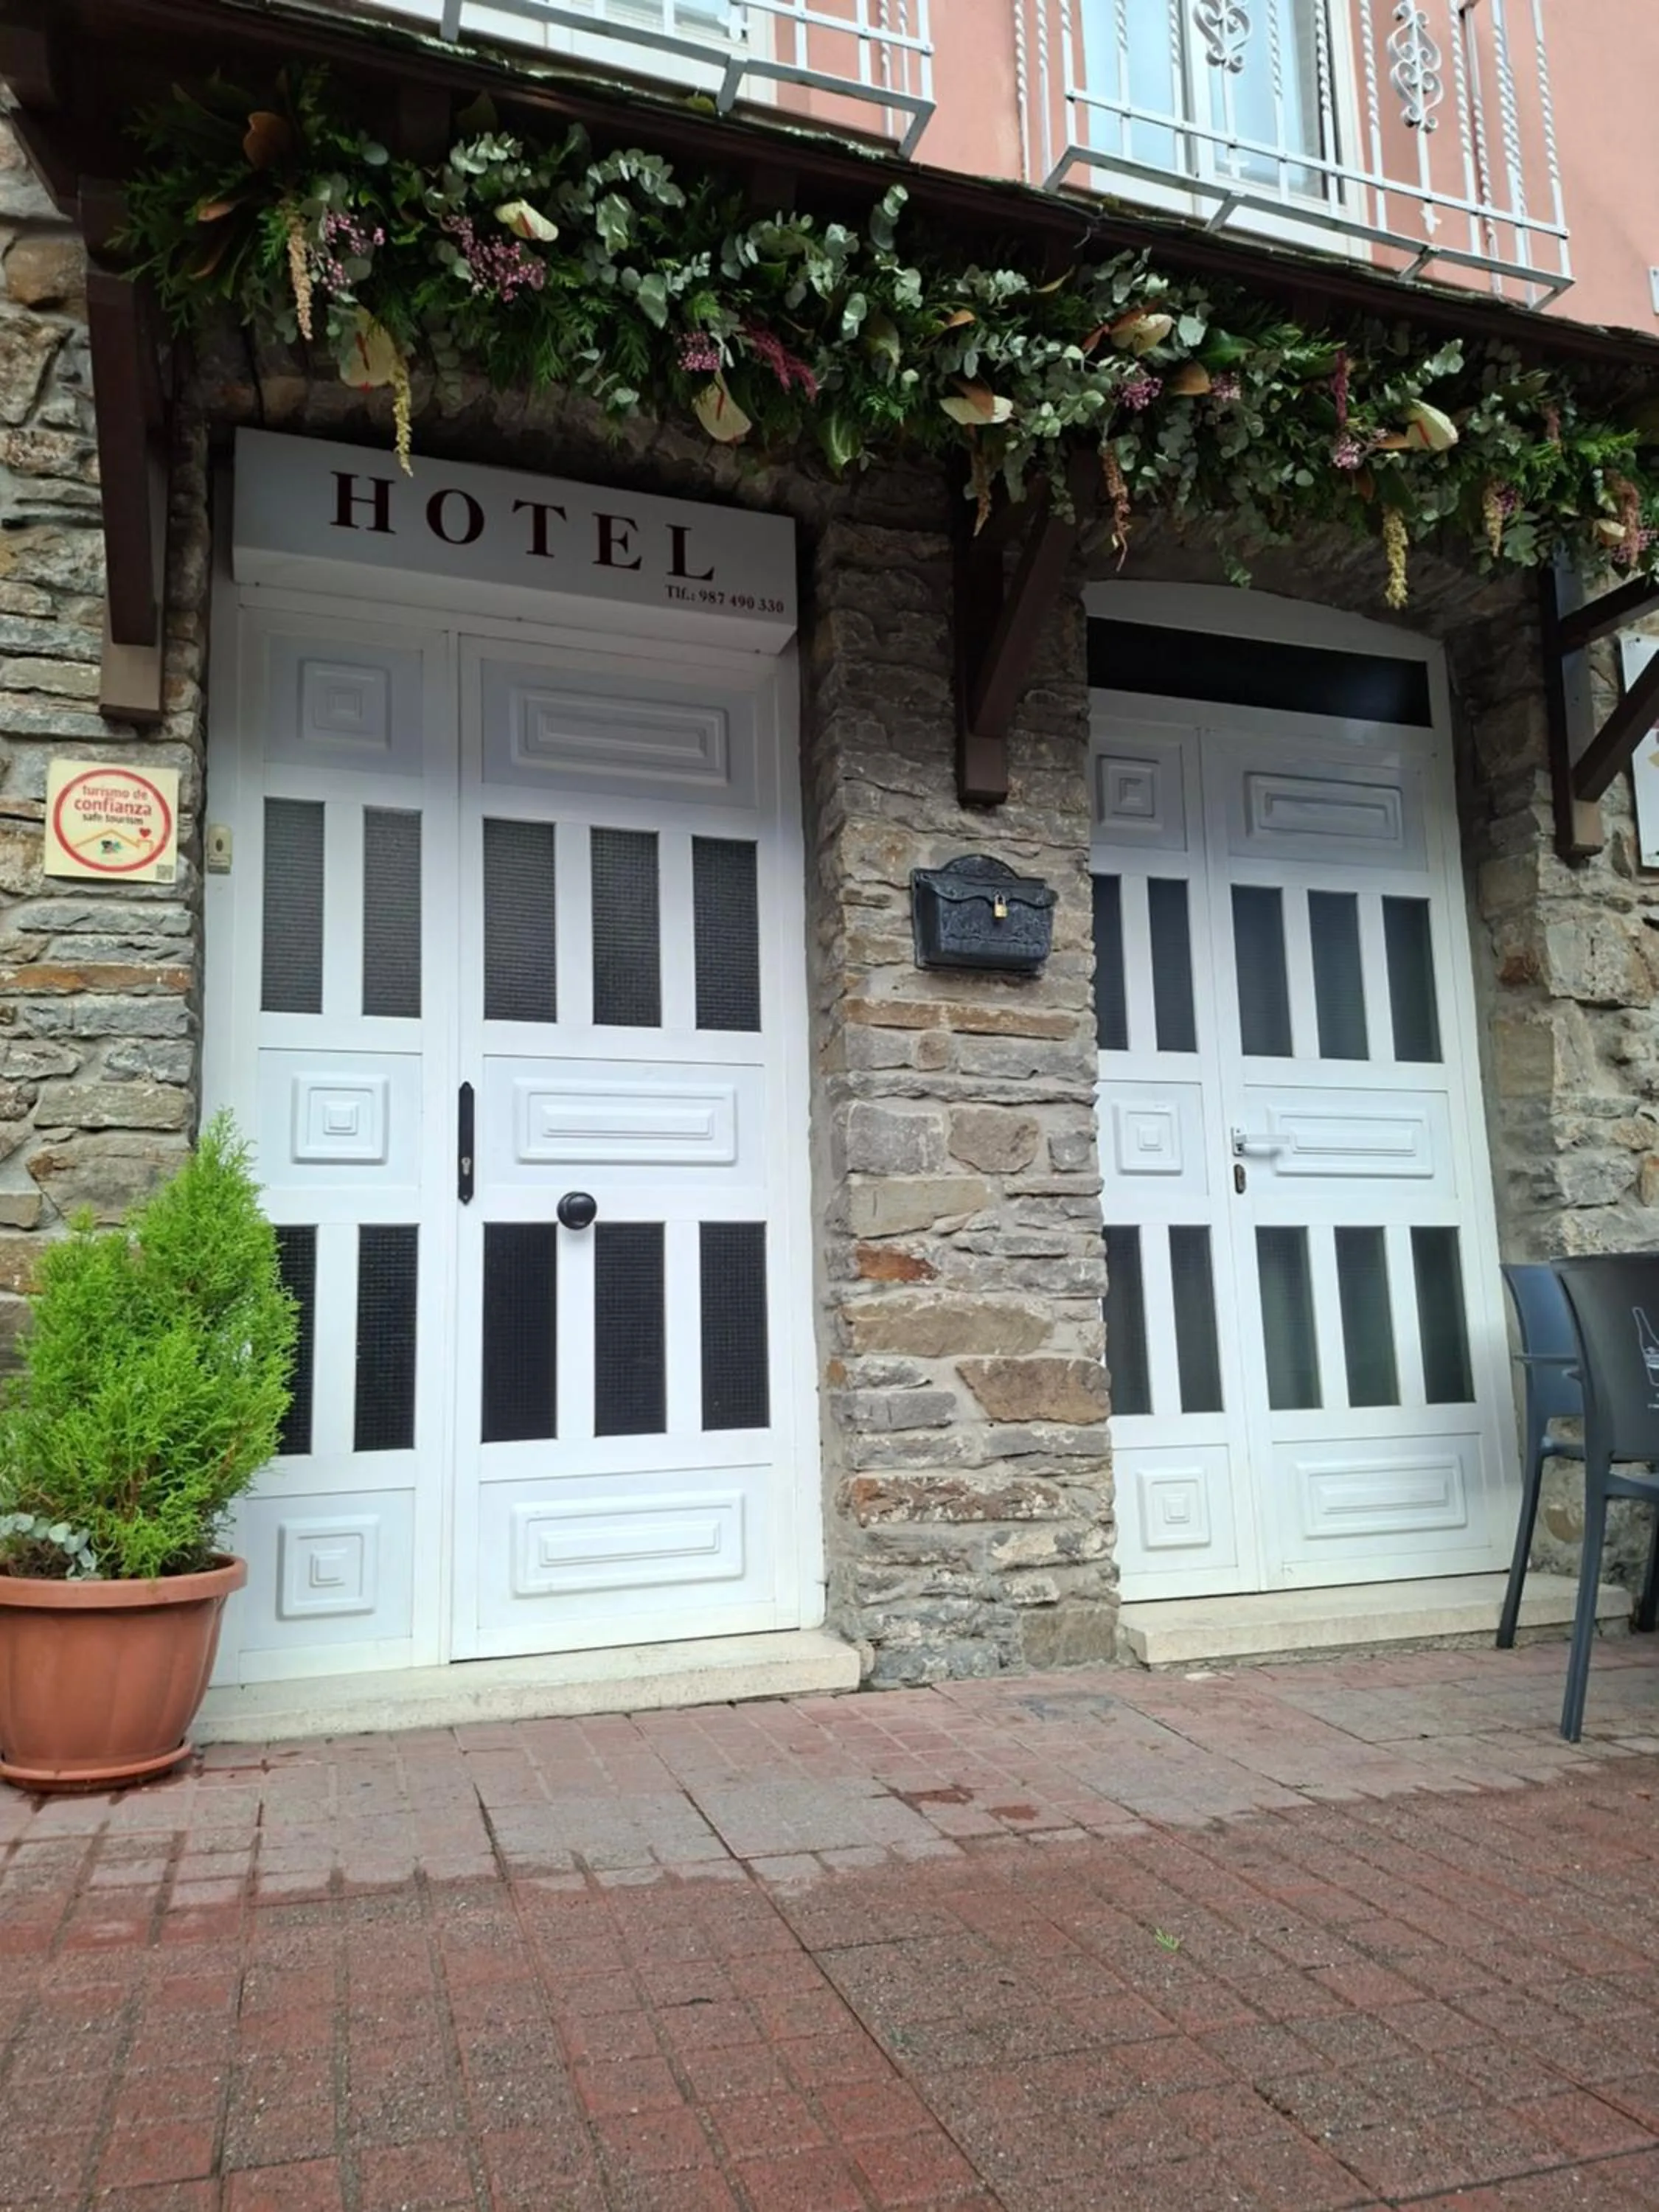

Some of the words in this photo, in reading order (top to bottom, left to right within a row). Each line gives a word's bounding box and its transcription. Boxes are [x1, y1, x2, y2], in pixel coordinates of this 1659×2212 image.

[330, 470, 714, 581] HOTEL
[699, 590, 724, 605] 987
[730, 594, 754, 610] 490
[758, 598, 785, 613] 330
[83, 785, 130, 799] turismo
[133, 789, 147, 800] de
[74, 797, 152, 816] confianza
[83, 813, 102, 821] safe
[105, 814, 144, 825] tourism
